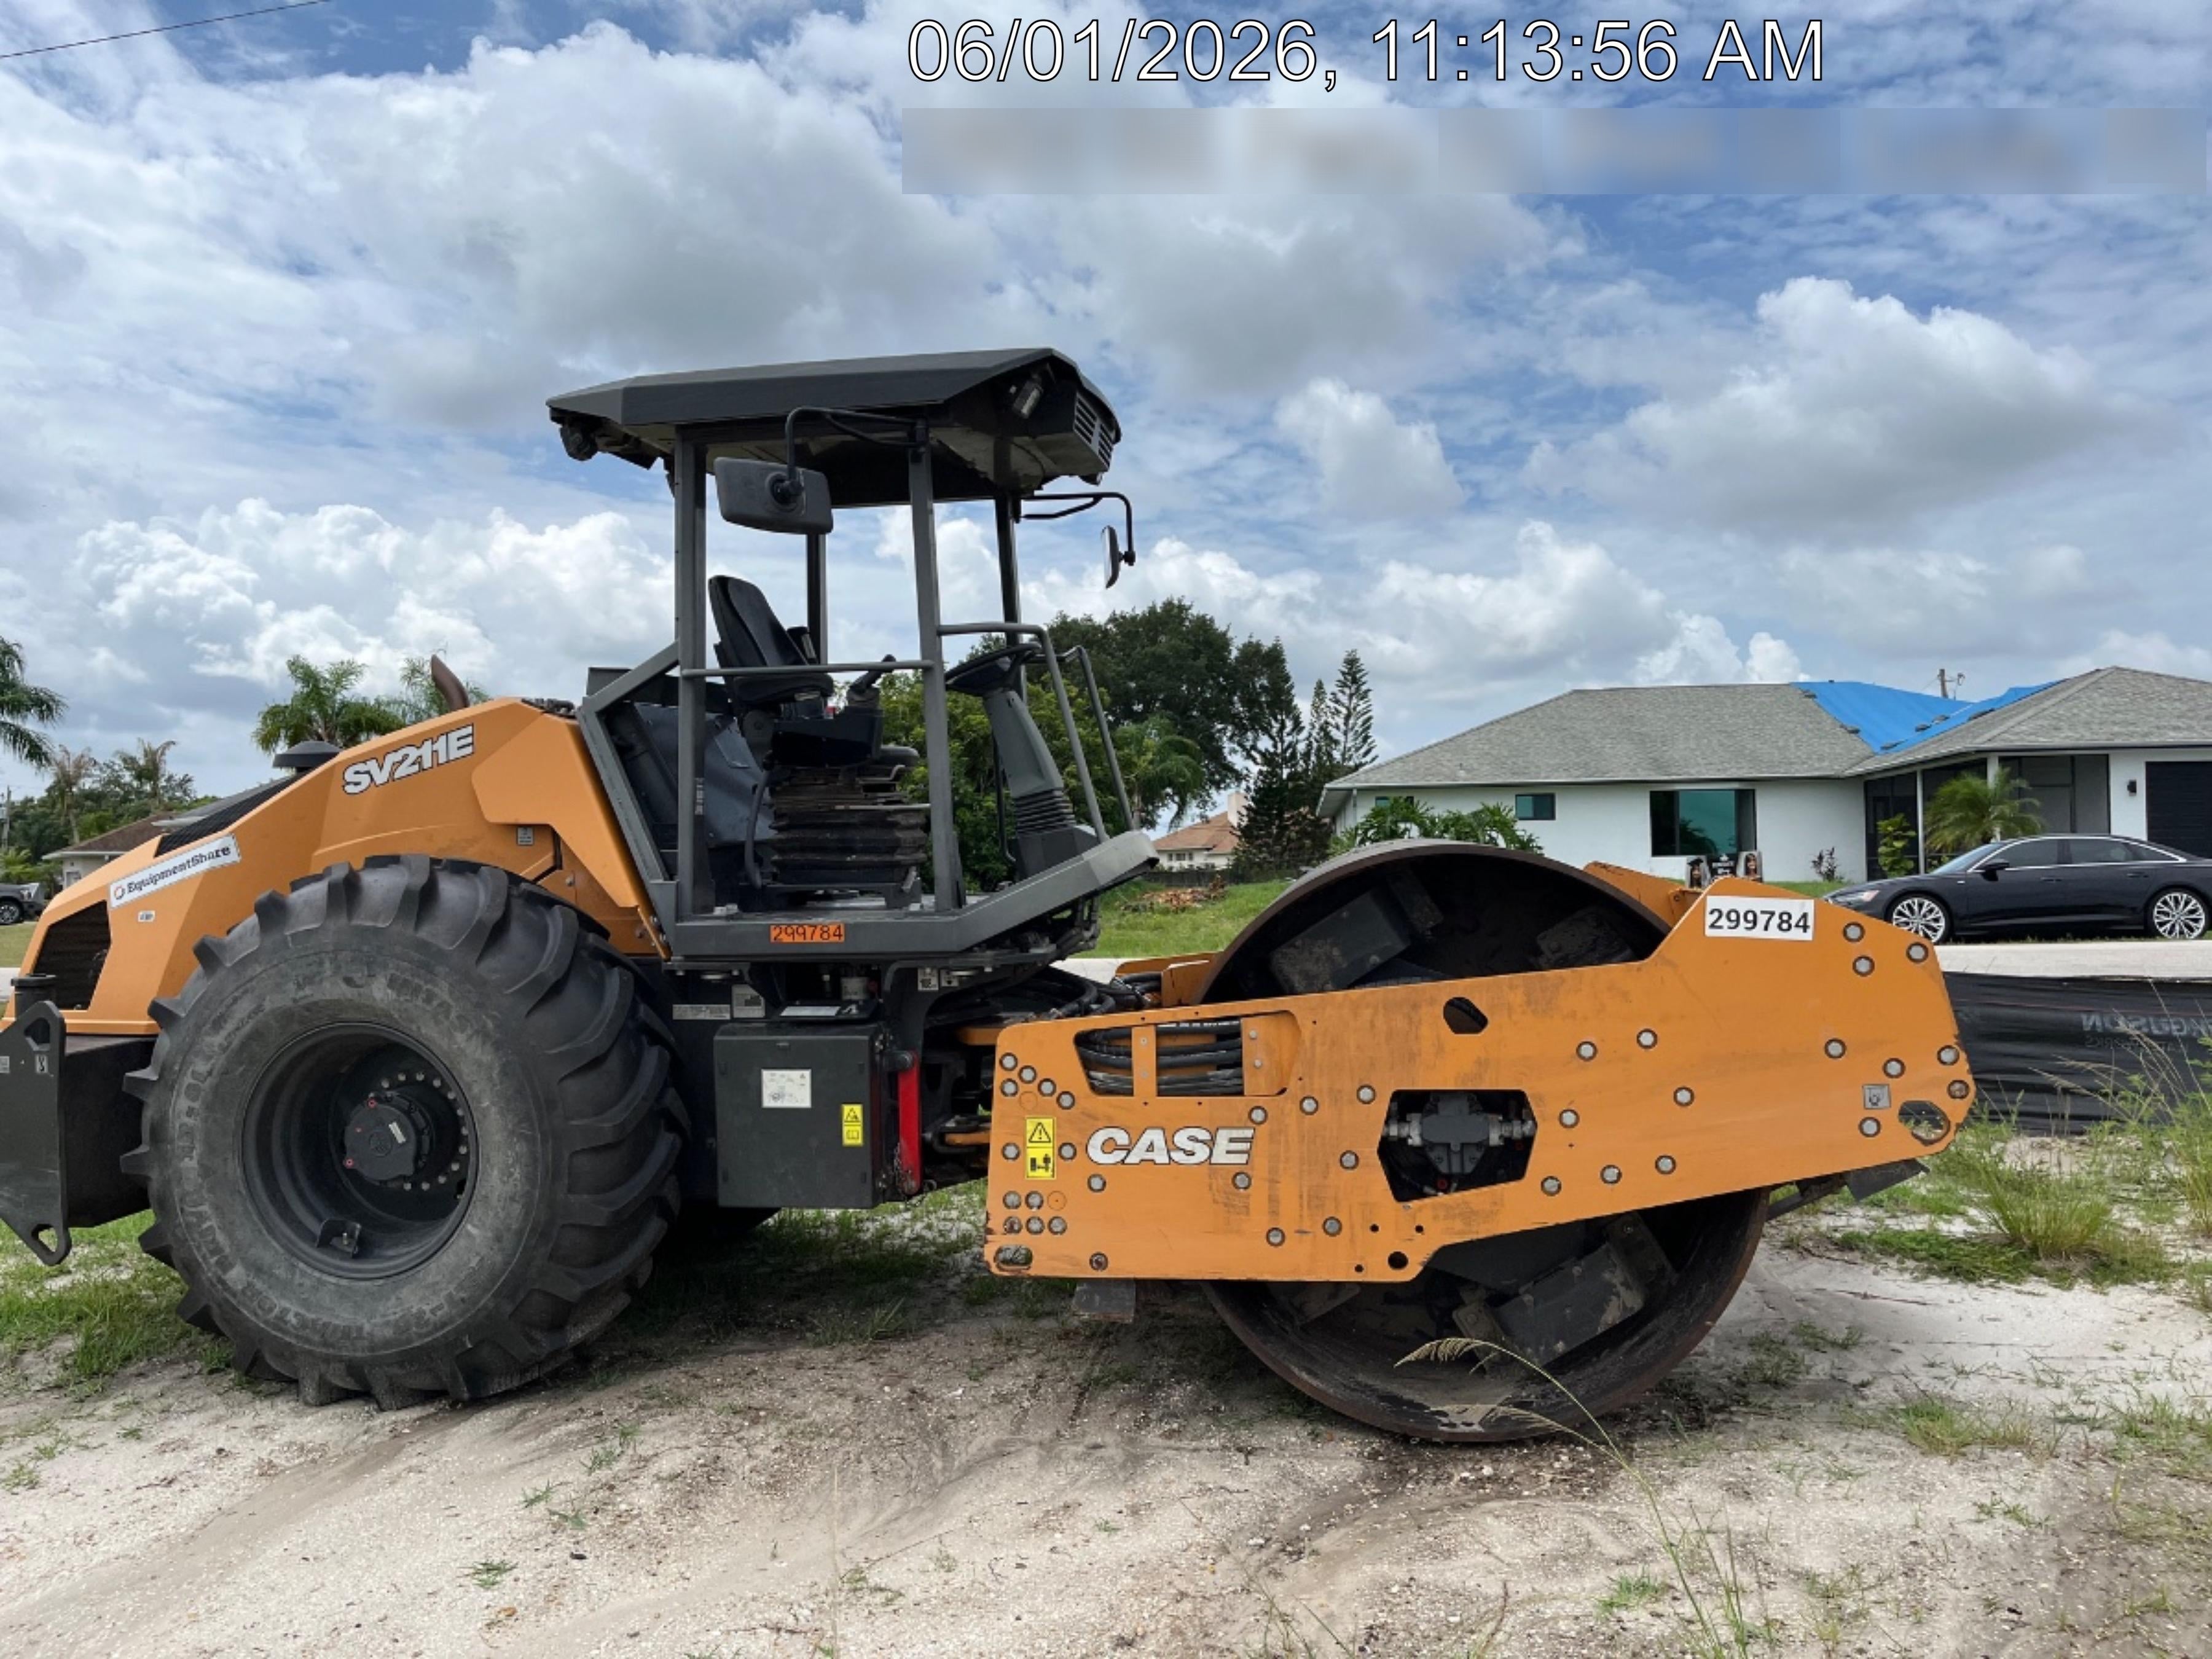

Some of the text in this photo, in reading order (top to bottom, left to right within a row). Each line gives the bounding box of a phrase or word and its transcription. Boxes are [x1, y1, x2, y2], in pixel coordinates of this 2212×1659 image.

[342, 723, 474, 794] SV211E
[127, 845, 232, 894] EquipmentShare
[773, 924, 843, 941] 299784
[1708, 908, 1810, 933] 299784
[1086, 1126, 1255, 1166] CASE
